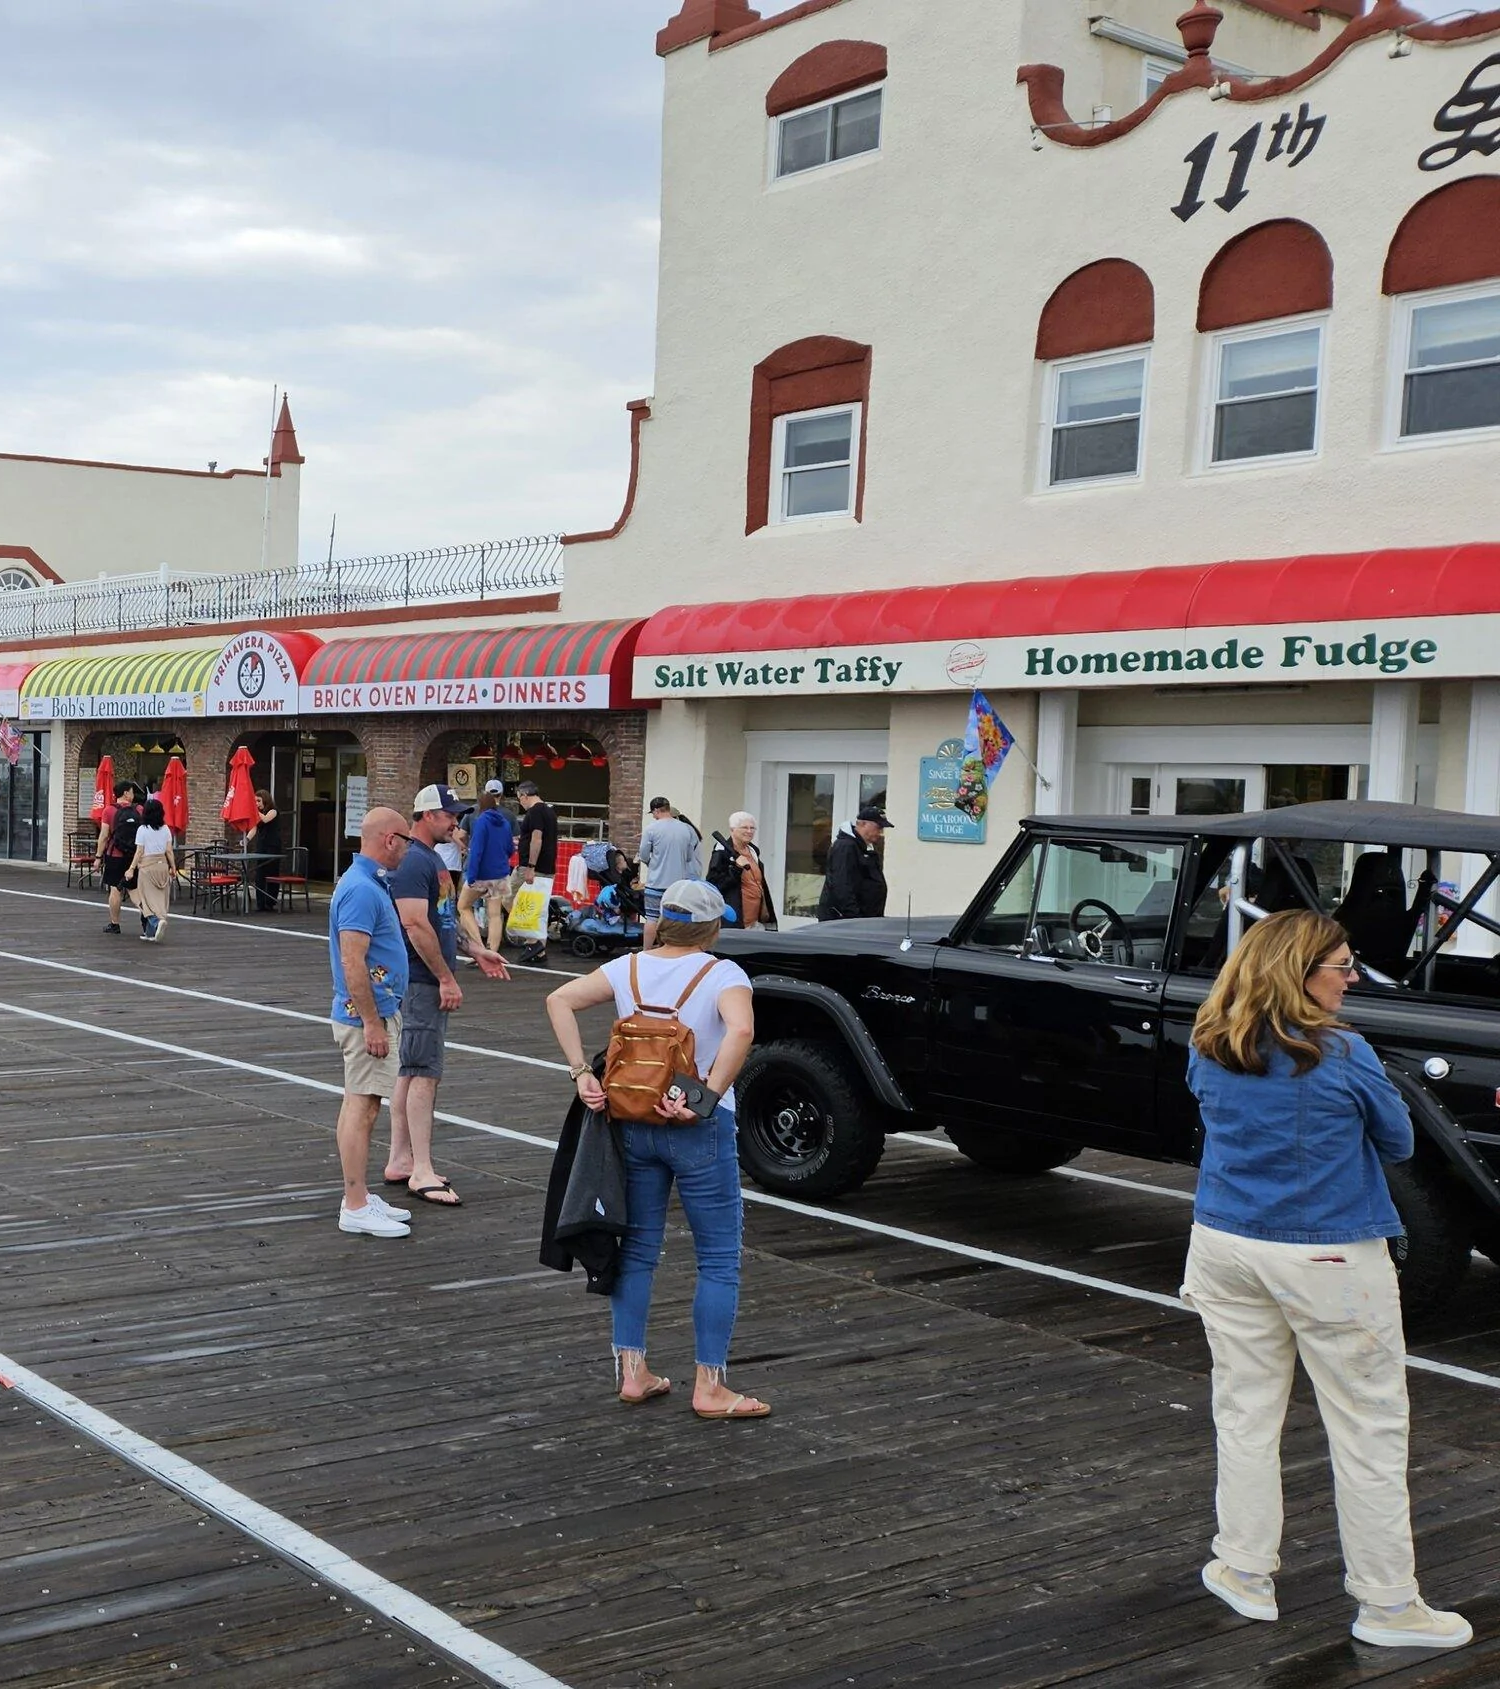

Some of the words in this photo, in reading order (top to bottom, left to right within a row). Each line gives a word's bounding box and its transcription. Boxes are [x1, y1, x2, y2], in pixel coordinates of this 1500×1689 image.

[1170, 102, 1327, 223] 11th
[214, 636, 264, 686] PRIMAVERA
[266, 642, 291, 684] PIZZA
[1024, 638, 1265, 676] Homemade
[1279, 632, 1438, 674] Fudge
[654, 664, 708, 688] Salt
[714, 661, 806, 686] Water
[814, 655, 903, 687] Taffy
[51, 697, 86, 718] Bob's
[90, 694, 166, 717] Lemonade
[227, 699, 285, 712] RESTAURANT
[313, 687, 362, 708] BRICK
[368, 684, 417, 707] OVEN
[425, 683, 479, 705] PIZZA
[492, 680, 587, 704] DINNERS
[928, 768, 953, 780] SINCE
[934, 823, 964, 835] FUDGE
[860, 985, 916, 1004] Bronco
